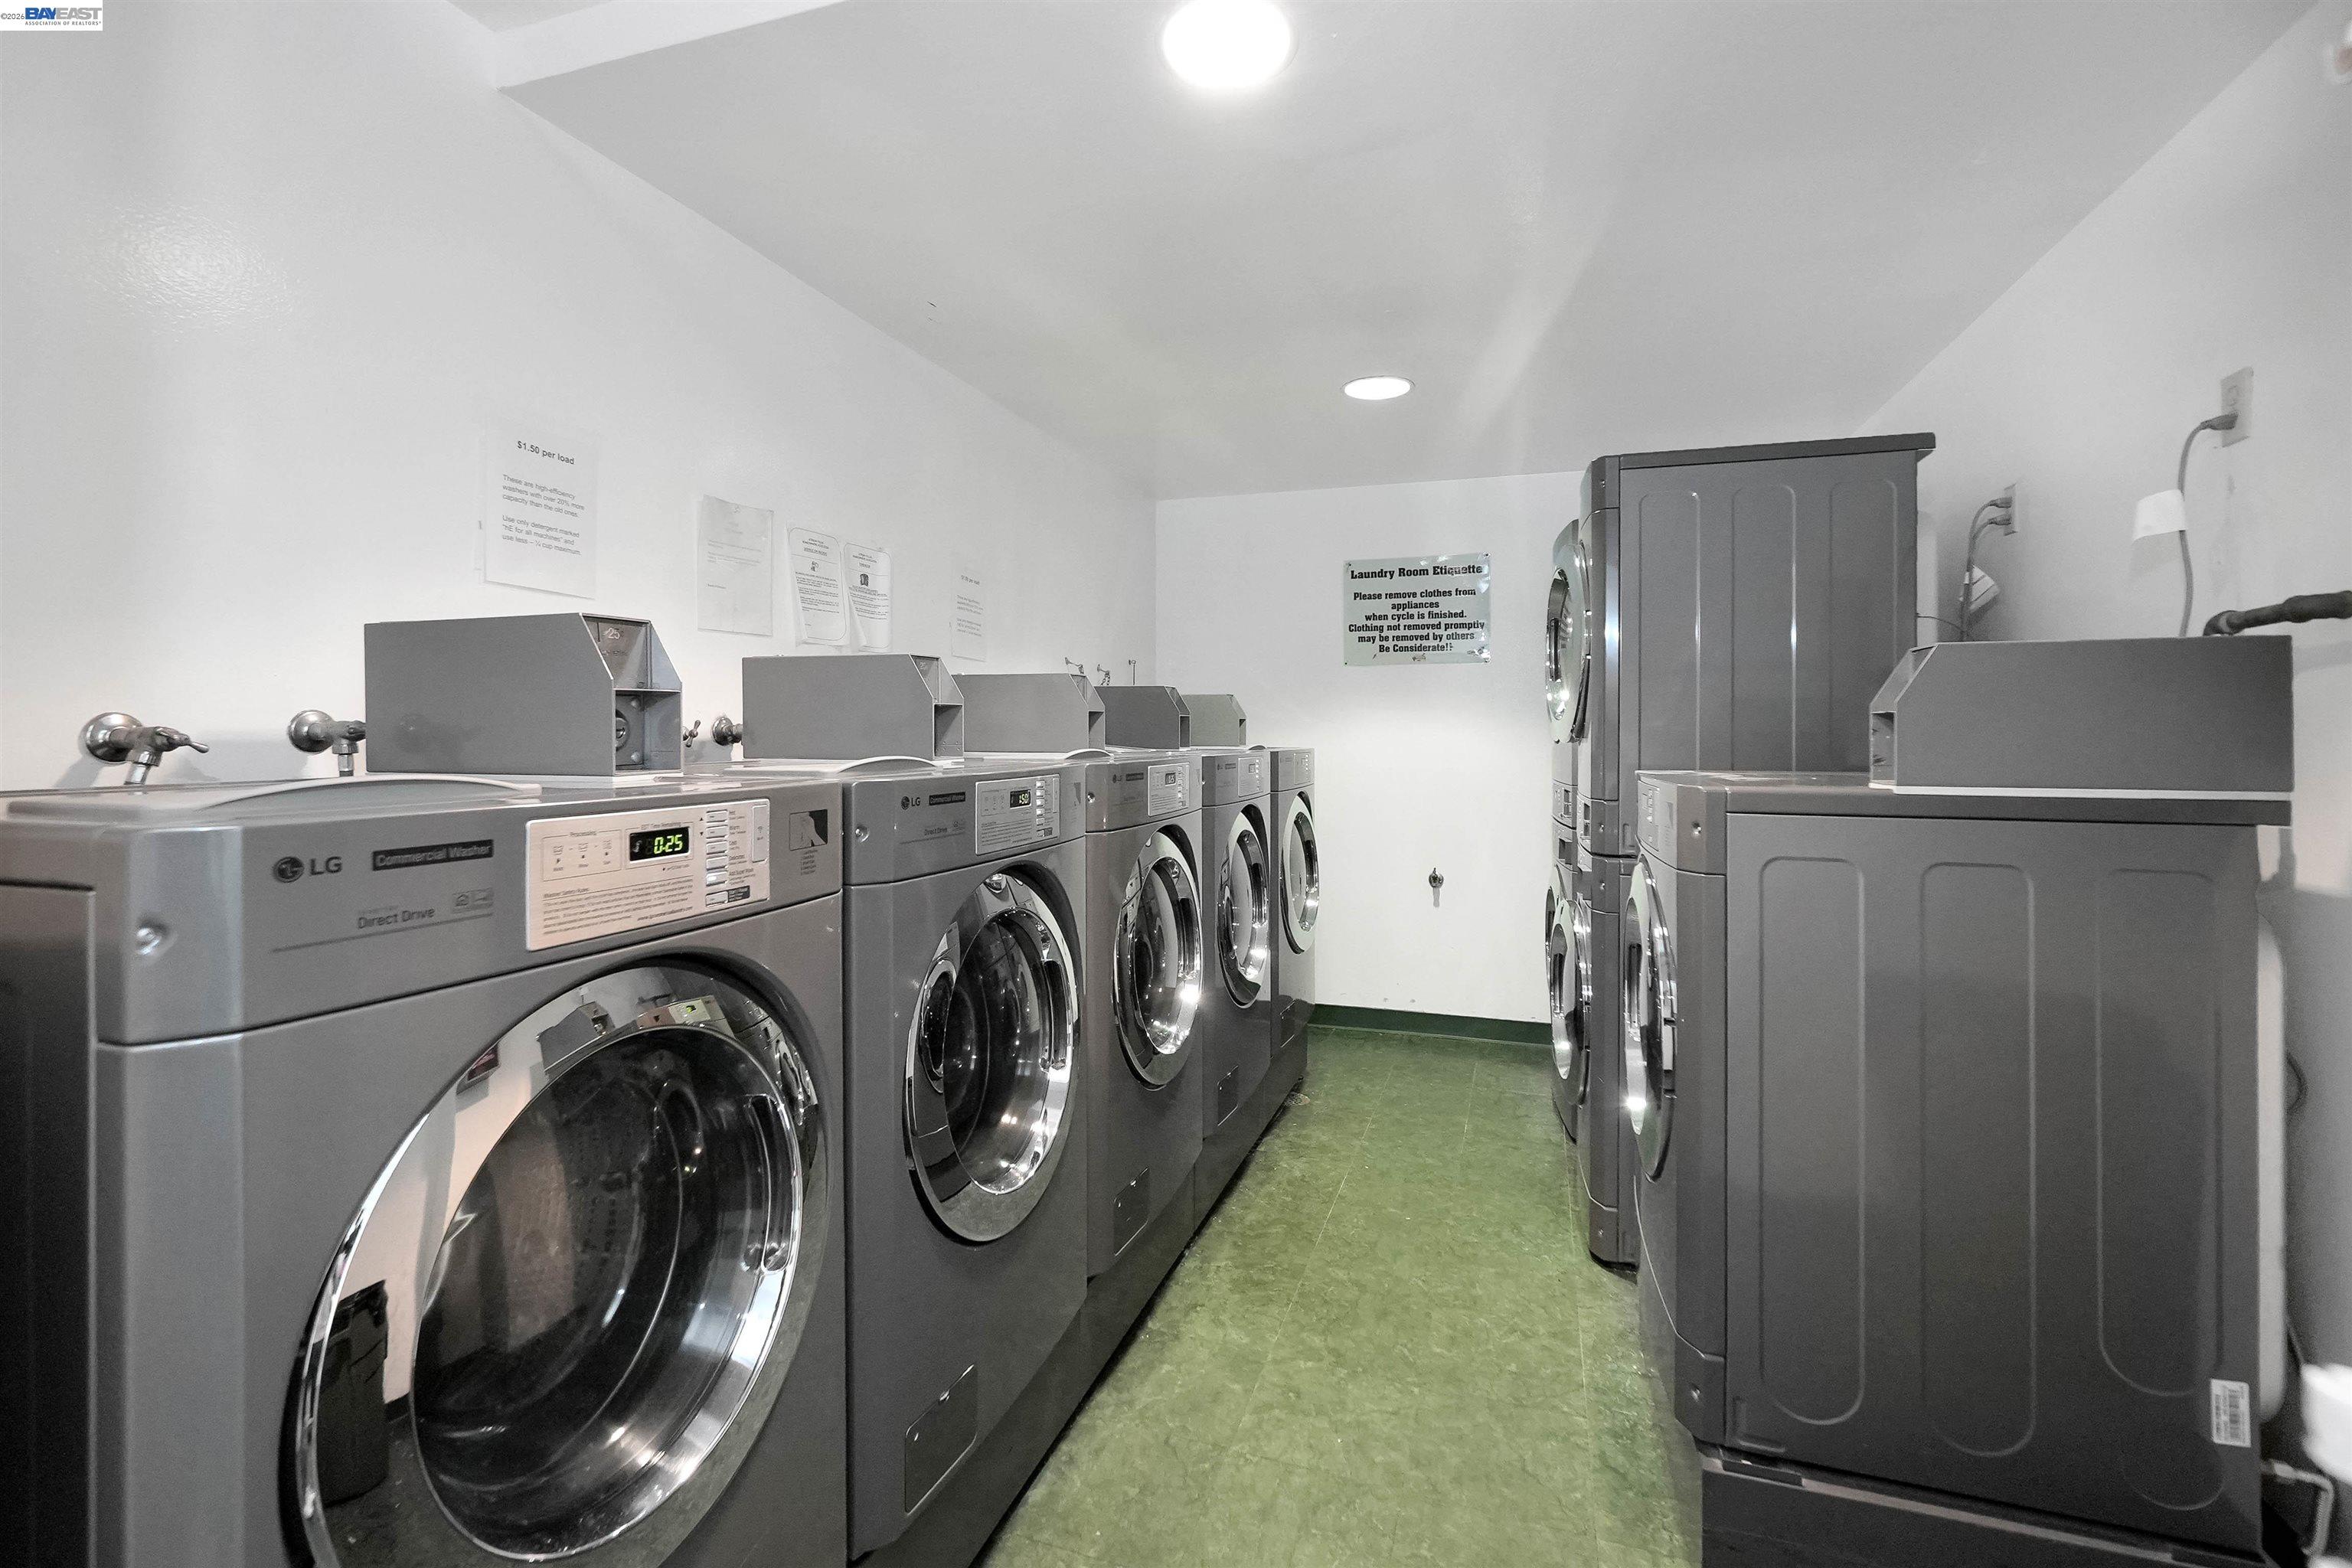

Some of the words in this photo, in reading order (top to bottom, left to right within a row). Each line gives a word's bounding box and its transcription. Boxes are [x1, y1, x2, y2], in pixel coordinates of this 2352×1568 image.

[517, 440, 540, 454] $1.50
[542, 449, 556, 459] per
[557, 453, 575, 465] load
[502, 485, 528, 495] washers
[503, 474, 523, 485] These
[535, 483, 576, 501] high-efficiency
[502, 494, 528, 505] capacity
[502, 514, 515, 523] Use
[516, 519, 529, 528] only
[531, 522, 558, 533] detergent
[1350, 569, 1395, 580] Laundry
[1398, 567, 1429, 577] Room
[1432, 564, 1483, 576] Etiquette
[1354, 592, 1383, 600] Please
[1455, 588, 1476, 596] from
[1391, 601, 1439, 611] appliances
[1365, 613, 1388, 622] when
[1391, 612, 1415, 622] cycle
[1428, 609, 1467, 619] finished.
[1348, 623, 1383, 633] Clothing
[1403, 622, 1442, 630] removed
[1444, 620, 1485, 631] promptly
[1357, 635, 1377, 644] may
[1392, 632, 1430, 641] removed
[1432, 632, 1443, 642] by
[1446, 632, 1475, 640] others
[1379, 644, 1390, 652] Be
[911, 797, 921, 806] LG
[375, 848, 447, 867] Commercial
[449, 844, 491, 858] Washer
[309, 856, 343, 876] LG
[358, 913, 398, 929] Direct
[400, 907, 436, 922] Drive
